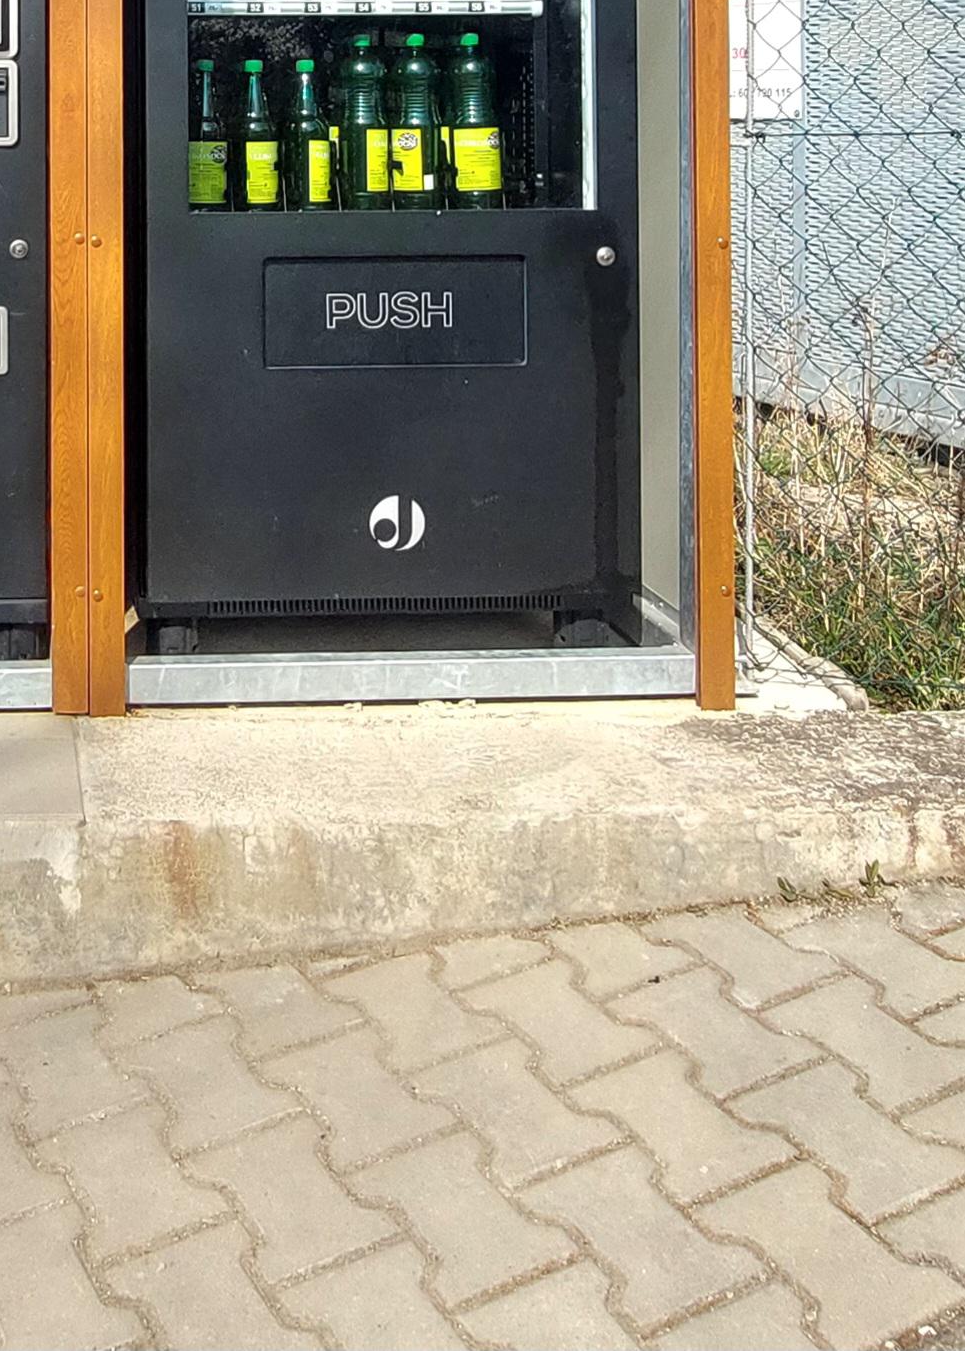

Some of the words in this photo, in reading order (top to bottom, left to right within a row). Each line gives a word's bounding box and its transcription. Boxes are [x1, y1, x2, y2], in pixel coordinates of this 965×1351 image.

[190, 2, 201, 12] 51
[250, 2, 261, 12] 52
[326, 291, 453, 329] PUSH
